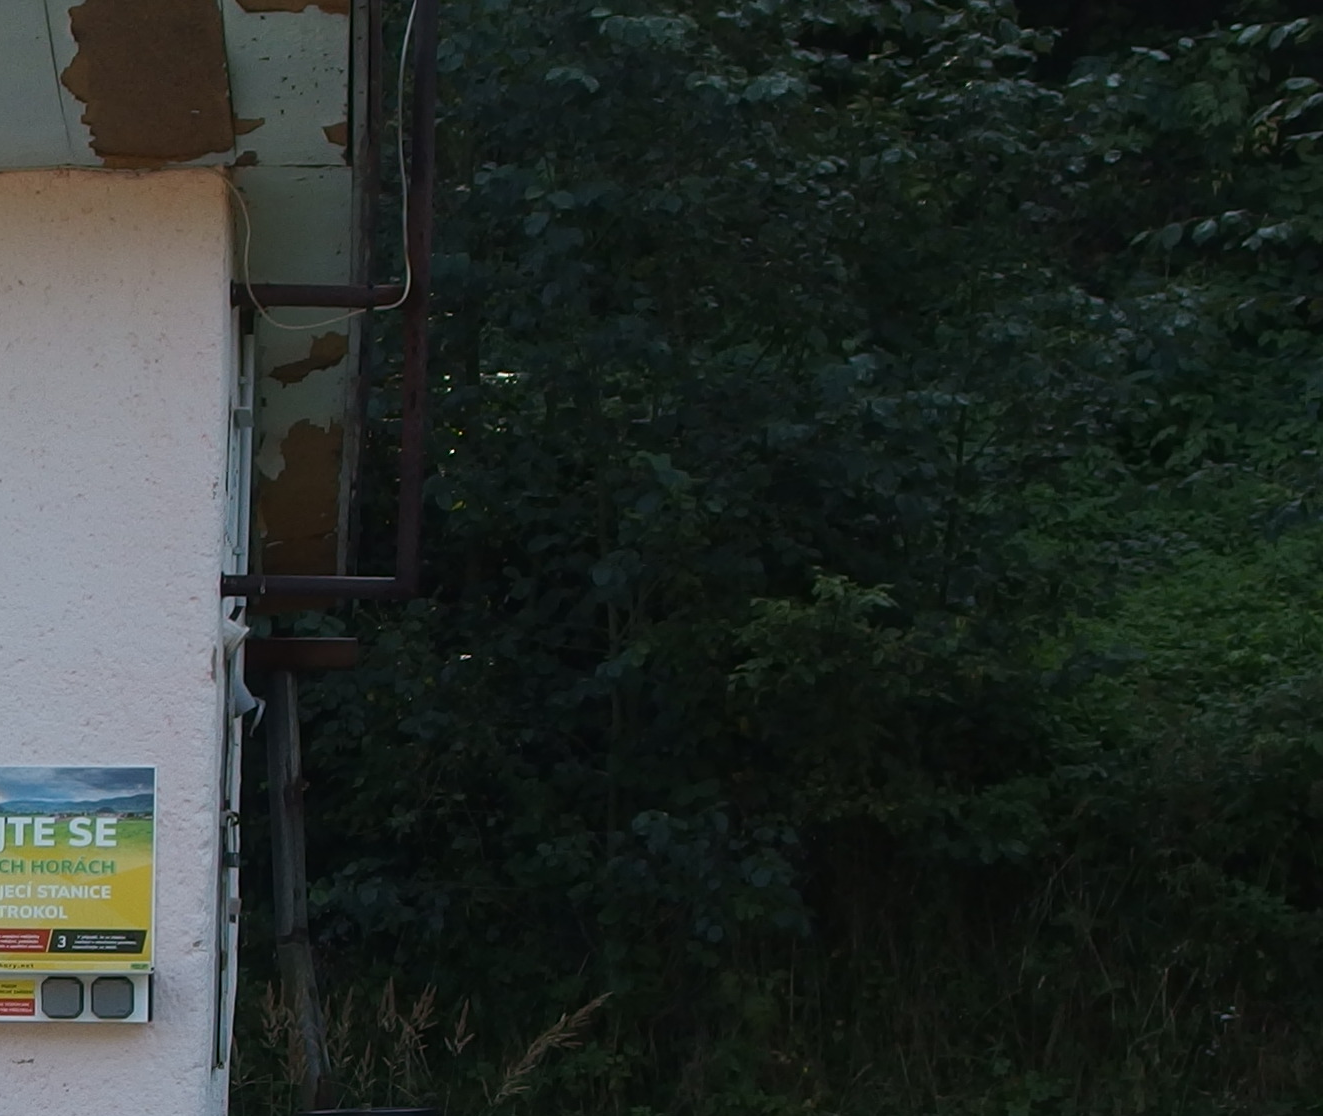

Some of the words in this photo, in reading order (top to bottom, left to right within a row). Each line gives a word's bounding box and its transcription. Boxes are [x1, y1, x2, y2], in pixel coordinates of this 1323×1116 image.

[68, 816, 117, 847] SE
[30, 857, 116, 874] HORÁCH
[37, 884, 112, 899] STANICE
[57, 935, 66, 948] 3
